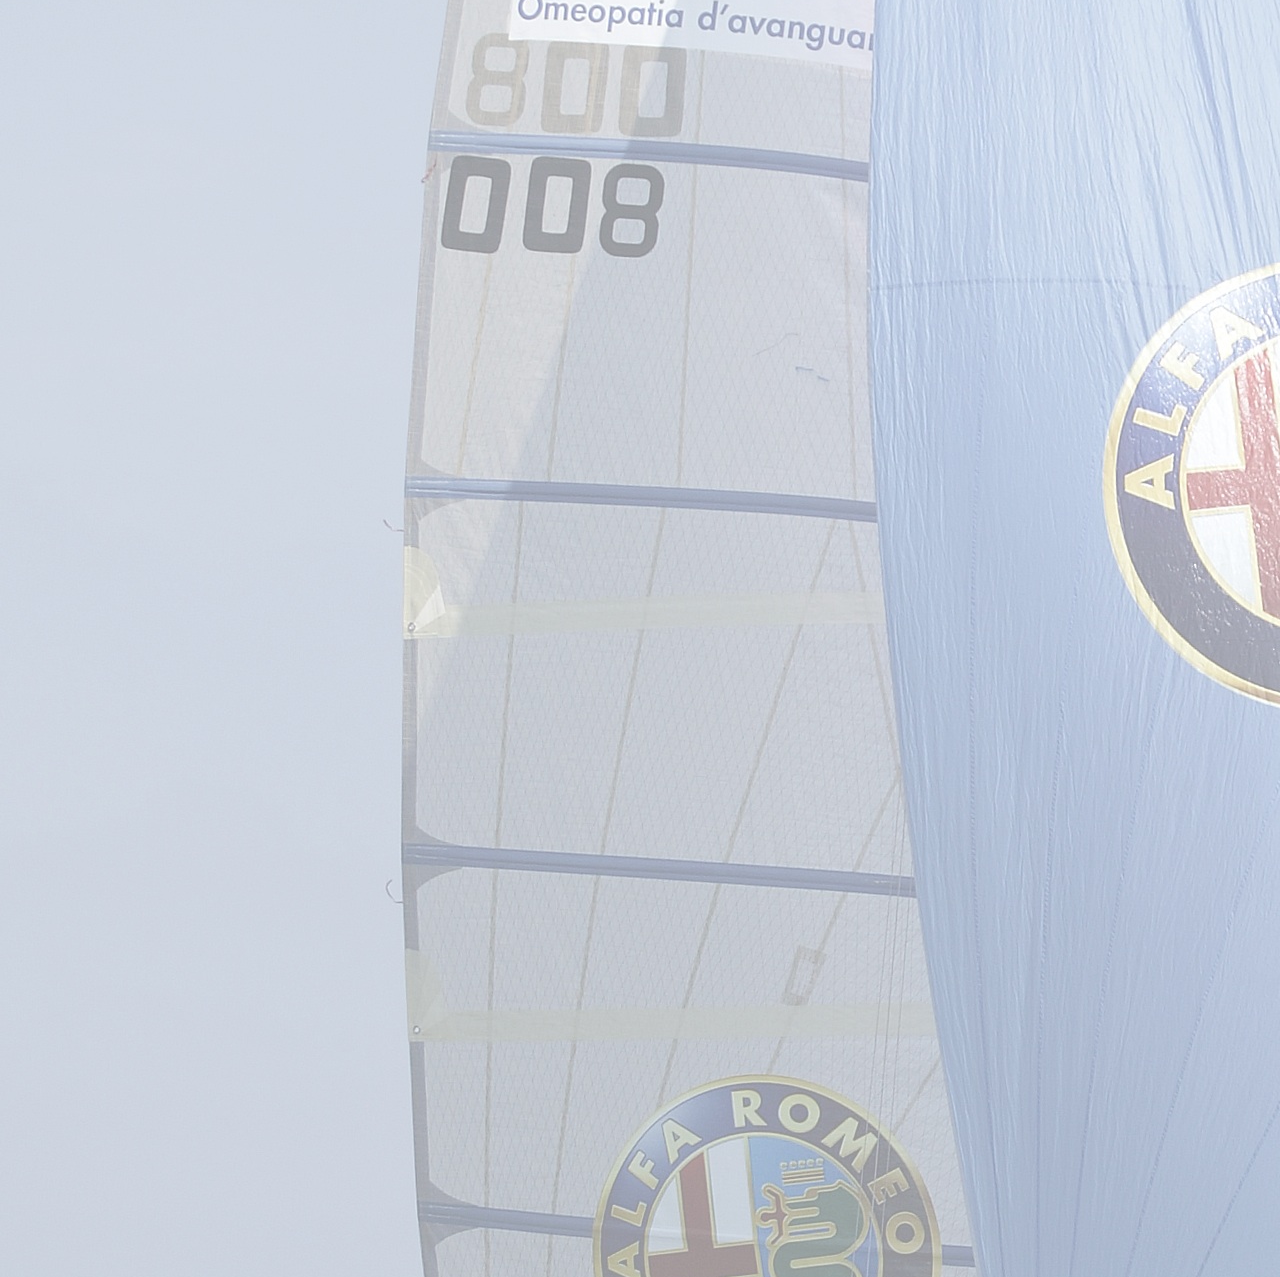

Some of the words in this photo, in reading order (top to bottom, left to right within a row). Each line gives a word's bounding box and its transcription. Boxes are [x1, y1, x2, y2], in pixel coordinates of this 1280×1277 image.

[440, 155, 665, 258] 008
[1123, 304, 1266, 511] ALFA
[731, 1089, 926, 1255] ROMEO
